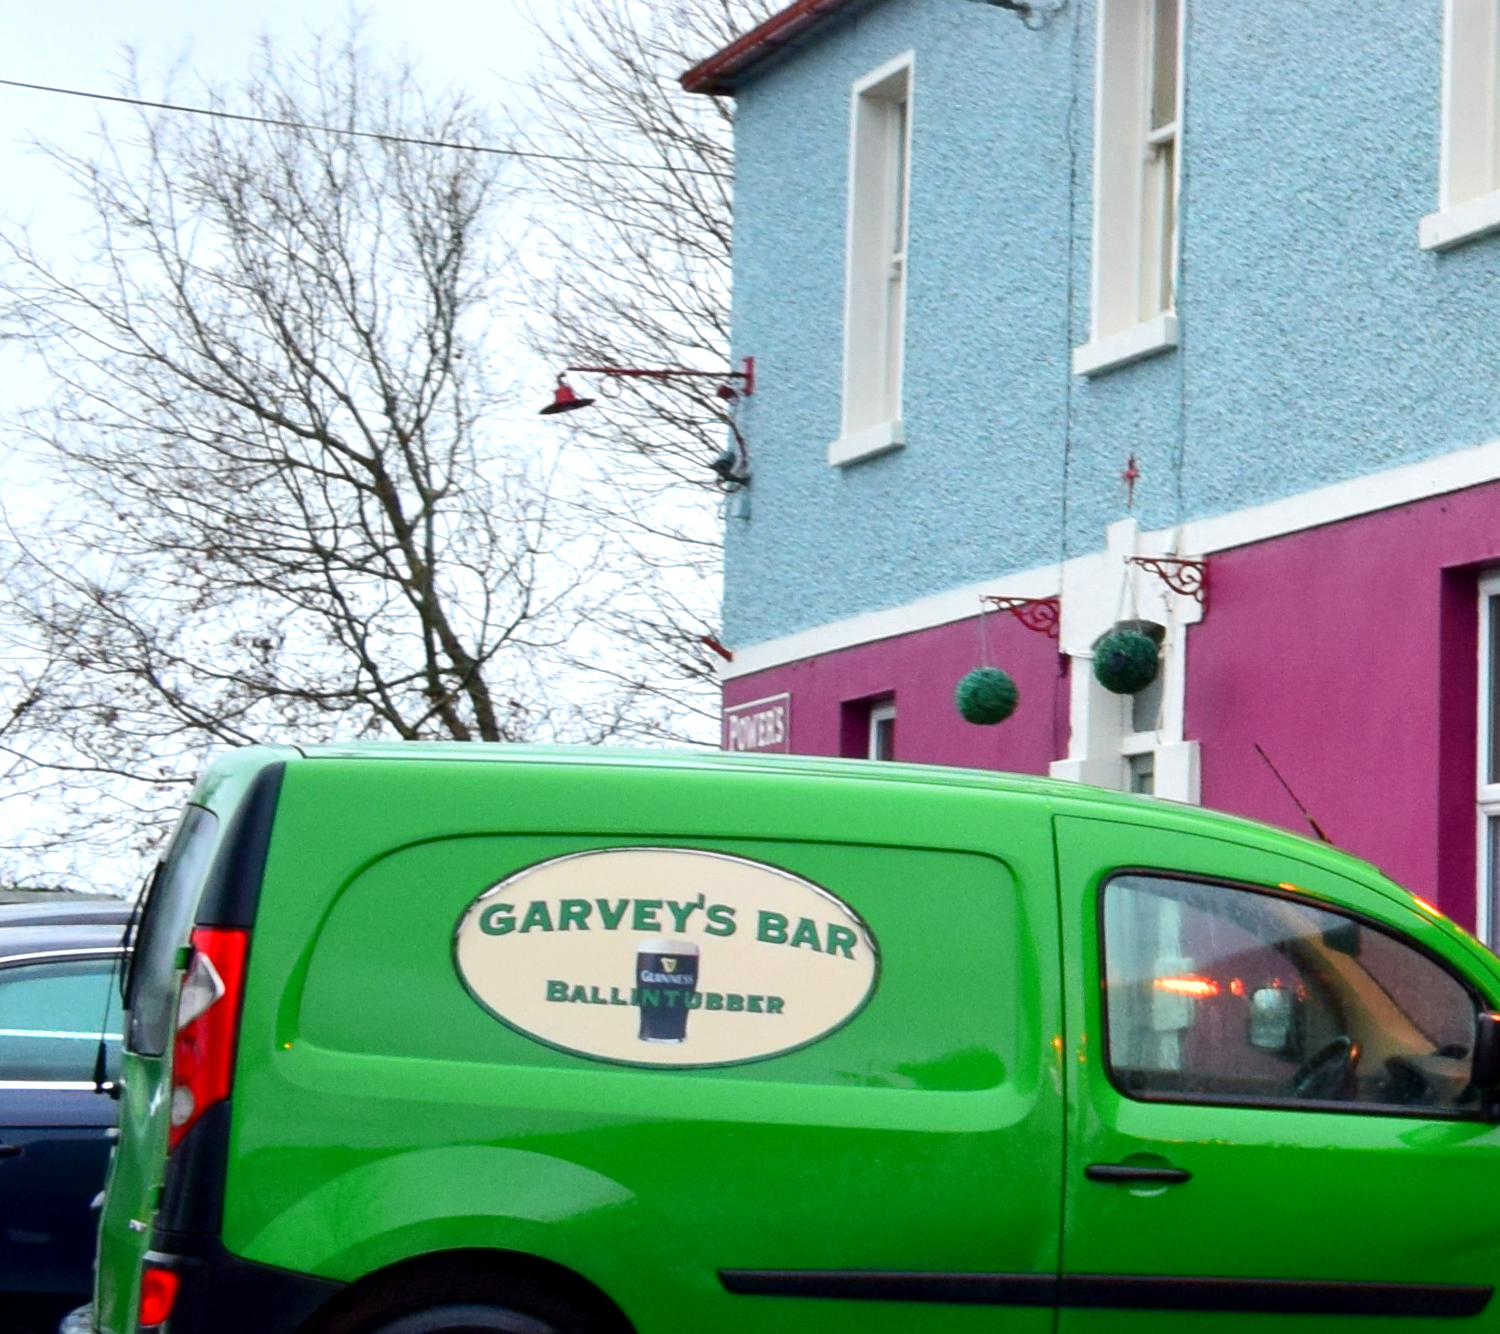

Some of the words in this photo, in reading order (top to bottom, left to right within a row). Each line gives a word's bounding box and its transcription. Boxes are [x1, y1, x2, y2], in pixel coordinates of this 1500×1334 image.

[479, 893, 736, 937] GARVEY'S
[756, 910, 858, 960] BAR
[641, 970, 694, 984] GUINNESS
[545, 980, 785, 1014] BALLINTUBBER
